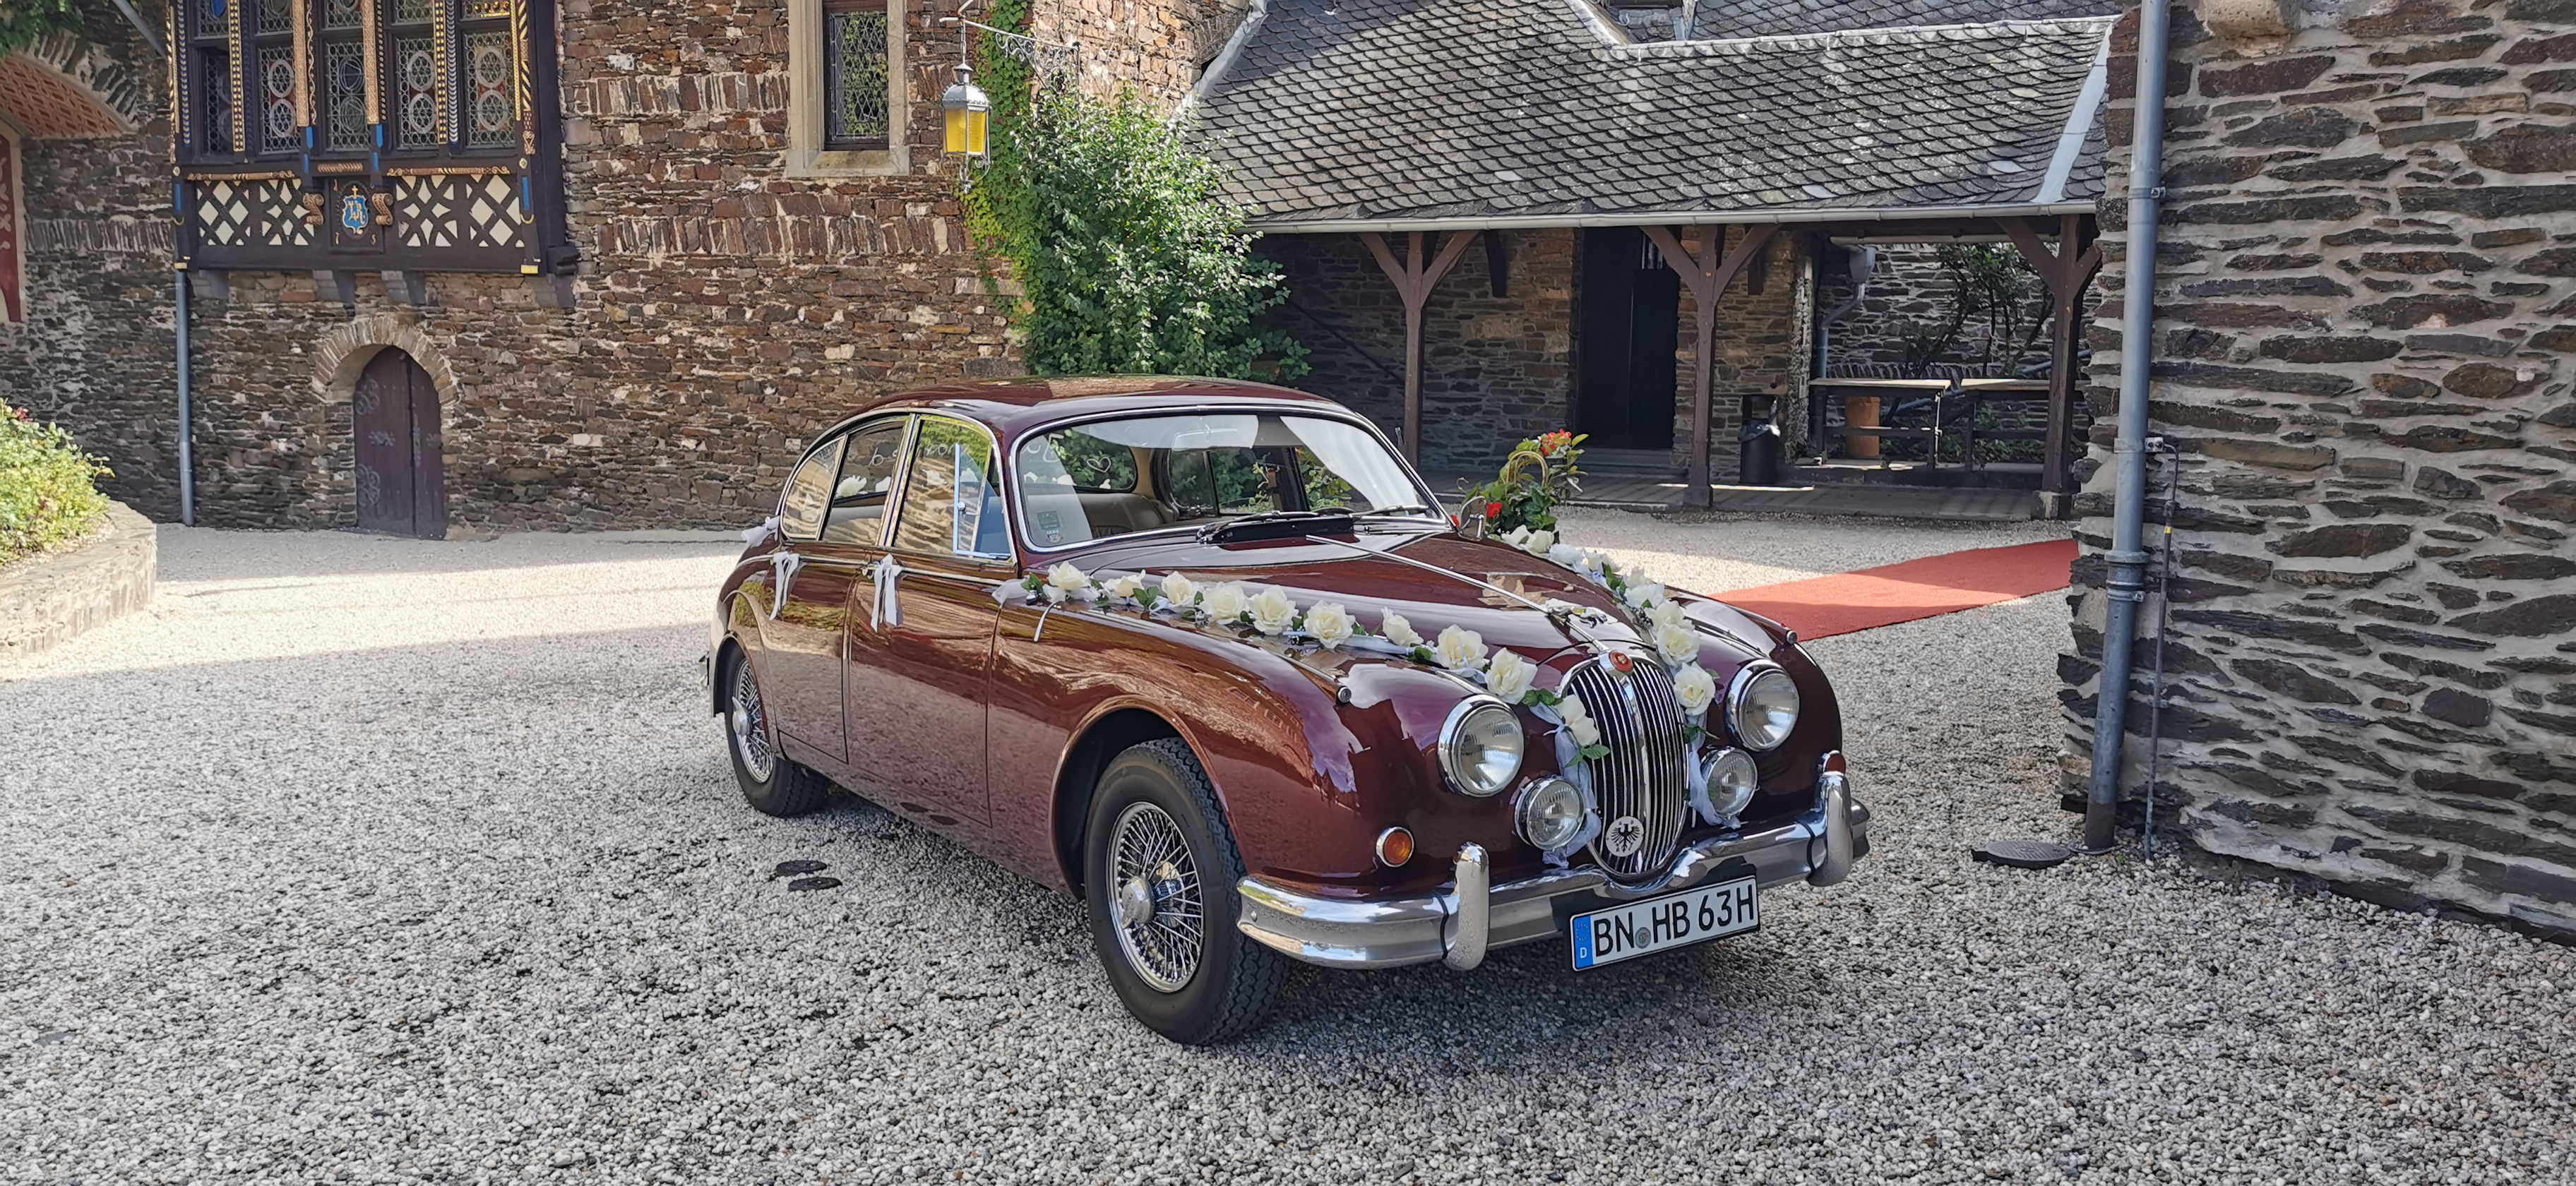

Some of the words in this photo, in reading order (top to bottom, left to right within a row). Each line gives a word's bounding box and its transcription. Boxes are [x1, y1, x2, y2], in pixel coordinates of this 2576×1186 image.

[1593, 911, 1635, 957] BN
[1652, 900, 1691, 944] HB
[1698, 884, 1754, 932] 63H
[1580, 947, 1587, 959] D
